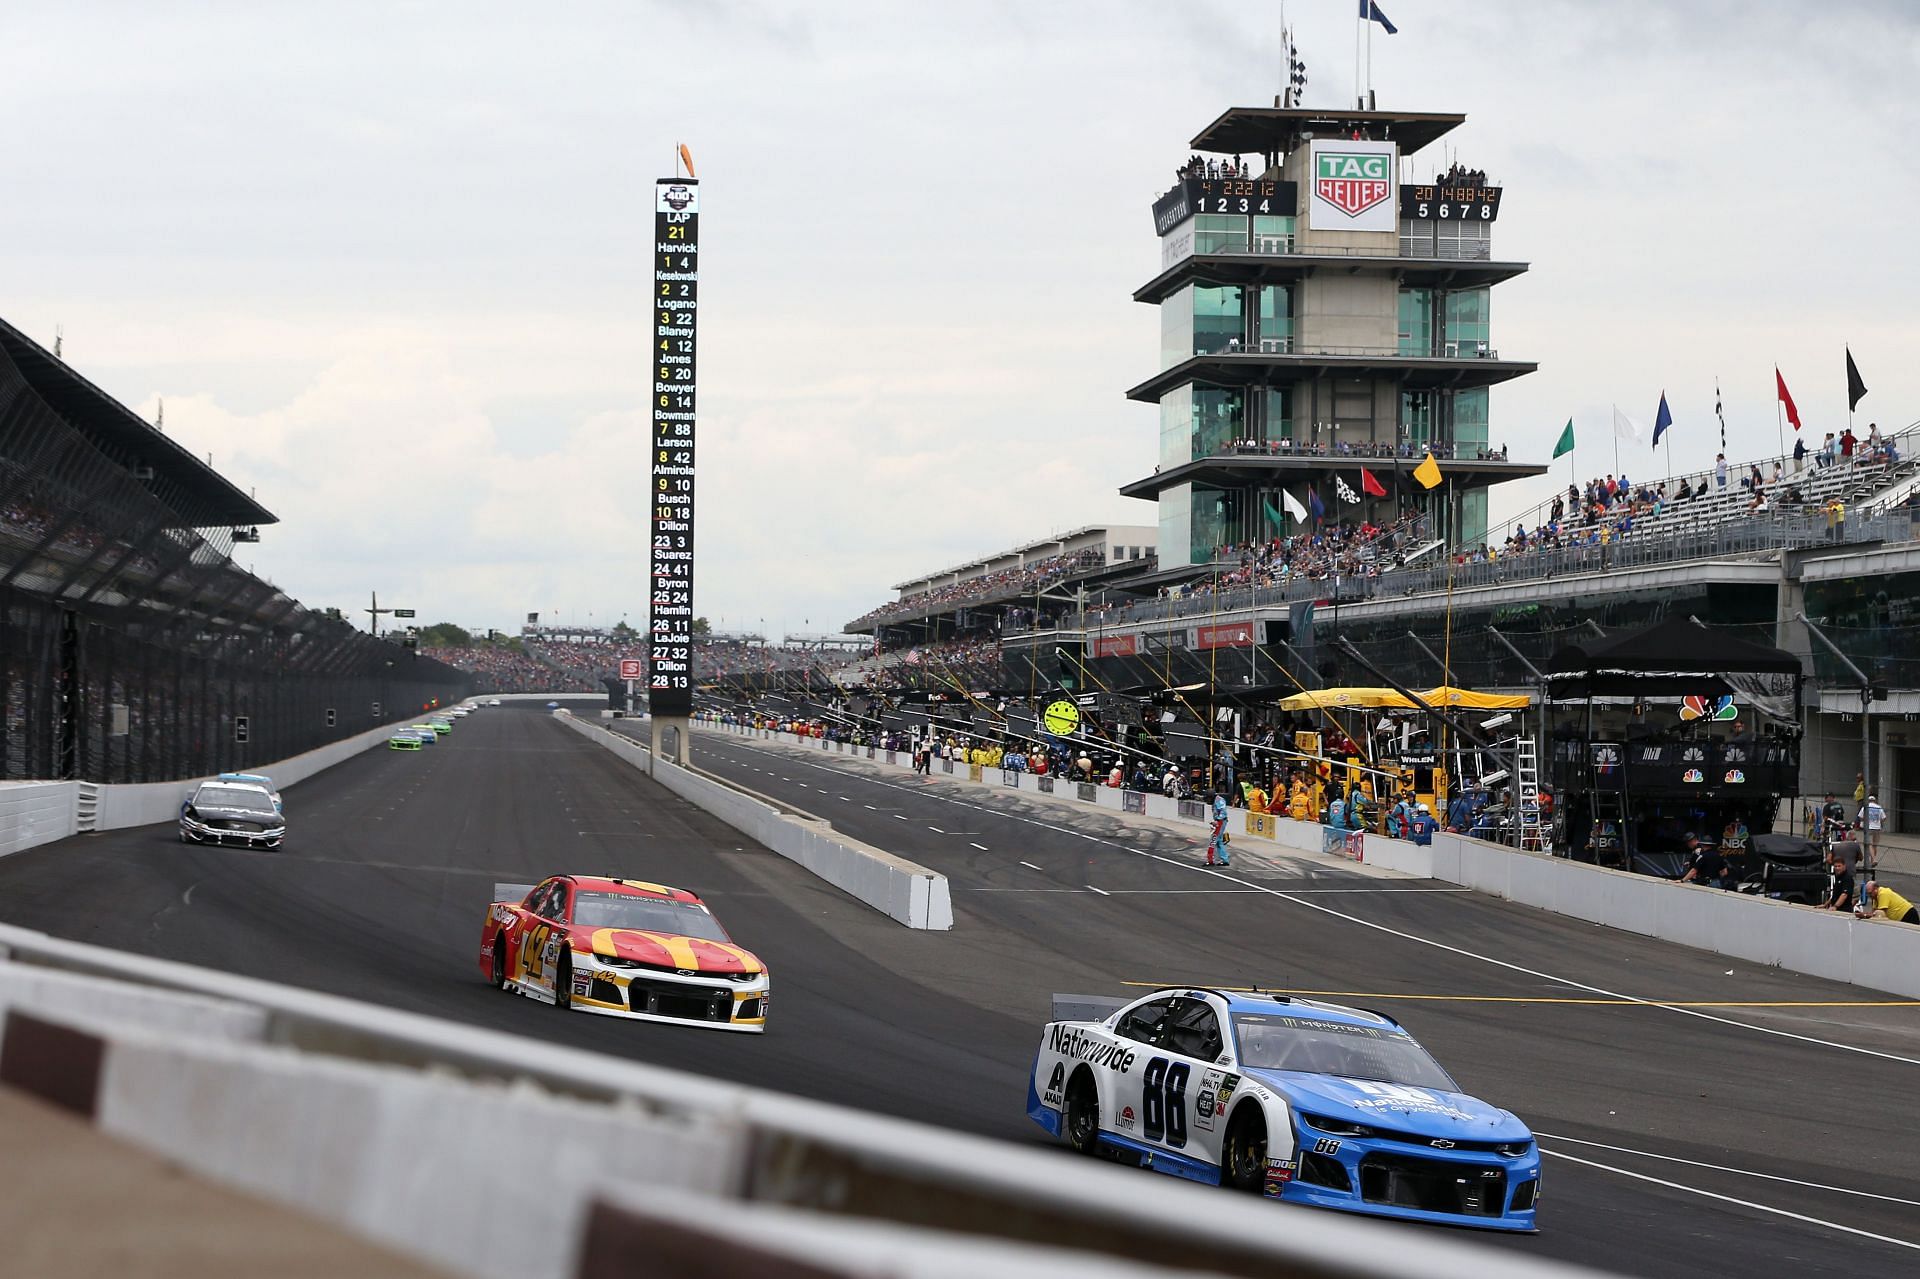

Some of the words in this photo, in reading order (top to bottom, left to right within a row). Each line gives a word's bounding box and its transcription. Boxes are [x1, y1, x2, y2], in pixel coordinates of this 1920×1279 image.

[1322, 157, 1383, 178] TAG
[1223, 181, 1232, 195] 2
[1235, 181, 1253, 196] 22
[1261, 182, 1274, 196] 12
[1415, 186, 1433, 201] 20
[1441, 187, 1454, 201] 14
[1457, 187, 1475, 202] 88
[1477, 188, 1495, 202] 42
[667, 191, 690, 200] 400
[1320, 180, 1387, 212] HEUER
[1197, 198, 1205, 212] 1
[1217, 198, 1228, 212] 2
[1239, 199, 1249, 212] 3
[1259, 199, 1270, 213] 4
[1418, 203, 1428, 217] 5
[1439, 204, 1449, 218] 6
[1460, 205, 1470, 218] 7
[1480, 205, 1490, 219] 8
[667, 213, 690, 223] LAP
[669, 227, 684, 239] 21
[658, 243, 696, 253] Harvick
[665, 256, 670, 267] 1
[681, 257, 688, 268] 4
[657, 270, 698, 282] Keselowski
[662, 284, 669, 295] 2
[681, 285, 688, 296] 2
[657, 298, 697, 310] Logano
[662, 312, 669, 323] 3
[677, 313, 692, 324] 22
[659, 326, 694, 338] Blaney
[661, 340, 668, 350] 4
[678, 341, 692, 352] 12
[660, 354, 691, 363] Jones
[661, 367, 668, 378] 5
[676, 368, 691, 379] 20
[656, 382, 696, 395] Bowyer
[661, 396, 668, 406] 6
[677, 396, 691, 407] 14
[655, 409, 696, 421] Bowman
[660, 423, 668, 434] 7
[675, 424, 690, 435] 88
[658, 437, 692, 447] Larson
[660, 451, 667, 462] 8
[674, 452, 690, 463] 42
[653, 464, 695, 476] Almirola
[660, 479, 667, 490] 9
[676, 480, 690, 491] 10
[659, 494, 690, 503] Busch
[657, 507, 671, 519] 10
[675, 508, 690, 519] 18
[660, 521, 688, 531] Dillon
[655, 535, 670, 547] 23
[677, 537, 685, 547] 3
[655, 550, 692, 559] Suarez
[654, 563, 670, 575] 24
[674, 564, 688, 575] 41
[658, 578, 688, 590] Byron
[654, 591, 669, 602] 25
[673, 592, 688, 603] 24
[655, 605, 690, 615] Hamlin
[654, 620, 669, 631] 26
[675, 621, 687, 631] 11
[655, 633, 689, 643] LaJoie
[653, 647, 669, 659] 27
[672, 648, 687, 659] 32
[657, 661, 686, 671] Dillon
[653, 675, 668, 686] 28
[673, 677, 687, 688] 13
[1721, 838, 1747, 849] NBC
[522, 922, 551, 979] 42
[597, 971, 617, 984] 42
[1300, 1020, 1363, 1034] MONSTER
[1049, 1025, 1135, 1074] Nationwide
[1142, 1056, 1191, 1150] 88
[1313, 1137, 1342, 1156] 88
